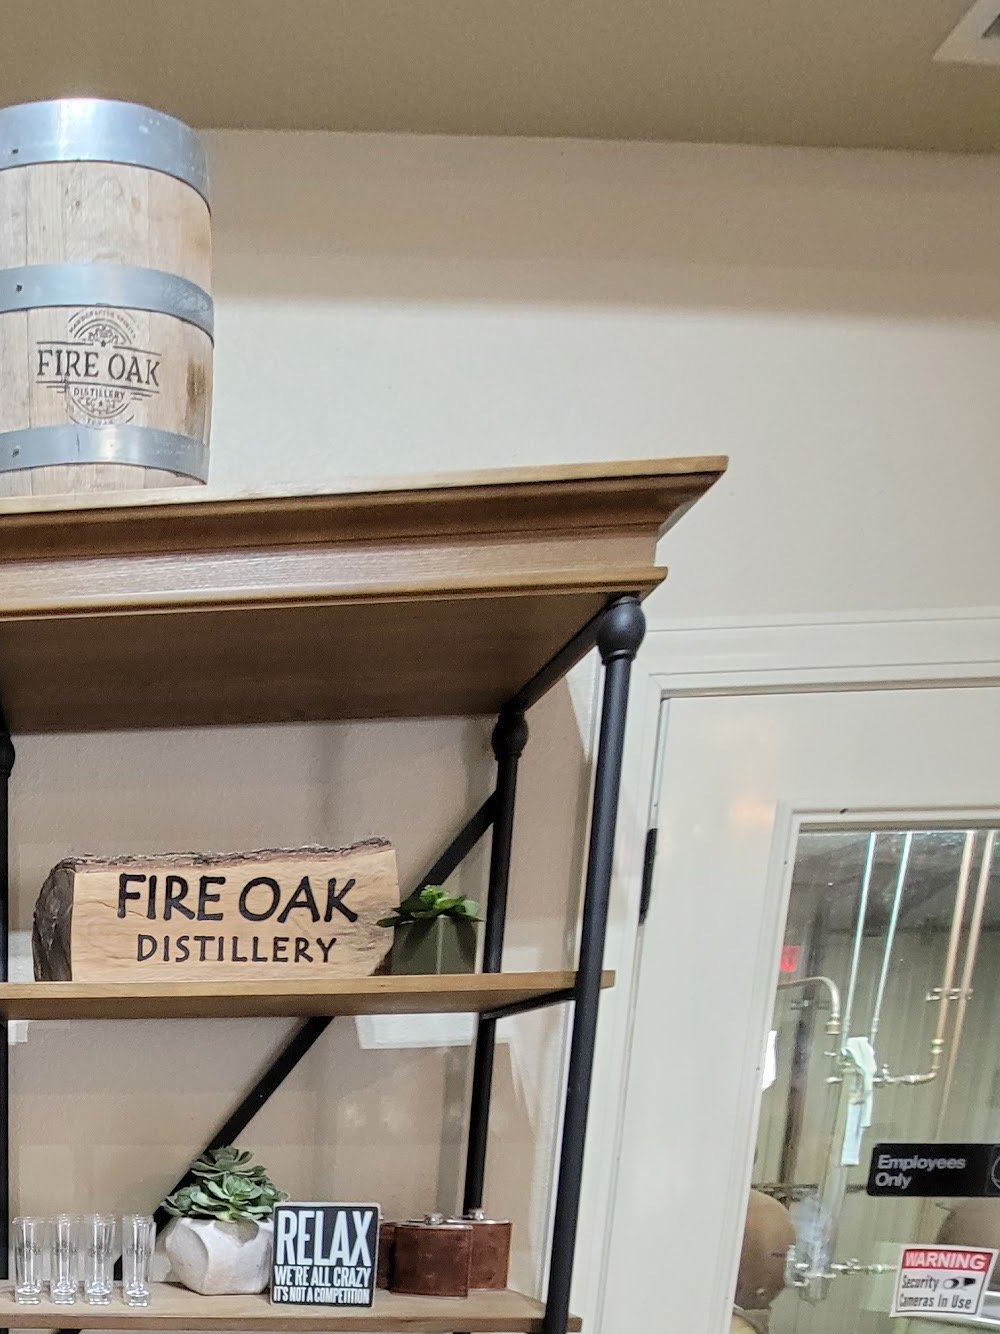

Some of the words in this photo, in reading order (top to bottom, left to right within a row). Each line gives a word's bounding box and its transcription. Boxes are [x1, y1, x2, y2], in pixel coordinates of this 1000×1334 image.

[36, 349, 99, 377] FIRE
[107, 353, 160, 387] OAK
[74, 387, 125, 399] DISTILLERY
[117, 872, 226, 921] FIRE
[238, 875, 359, 923] OAK
[137, 934, 338, 963] DISTILLERY
[877, 1154, 967, 1173] Employees
[875, 1172, 912, 1190] Only
[276, 1210, 373, 1267] RELAX
[904, 1250, 987, 1270] WARNING
[274, 1265, 310, 1286] WE'RE
[310, 1266, 331, 1287] ALL
[333, 1267, 372, 1288] CRAZY
[902, 1274, 940, 1292] Security
[273, 1286, 288, 1302] IT'S
[289, 1287, 307, 1303] NOT
[306, 1287, 314, 1303] A
[314, 1287, 371, 1304] COMPETITION
[938, 1294, 949, 1307] In
[951, 1294, 972, 1309] Use
